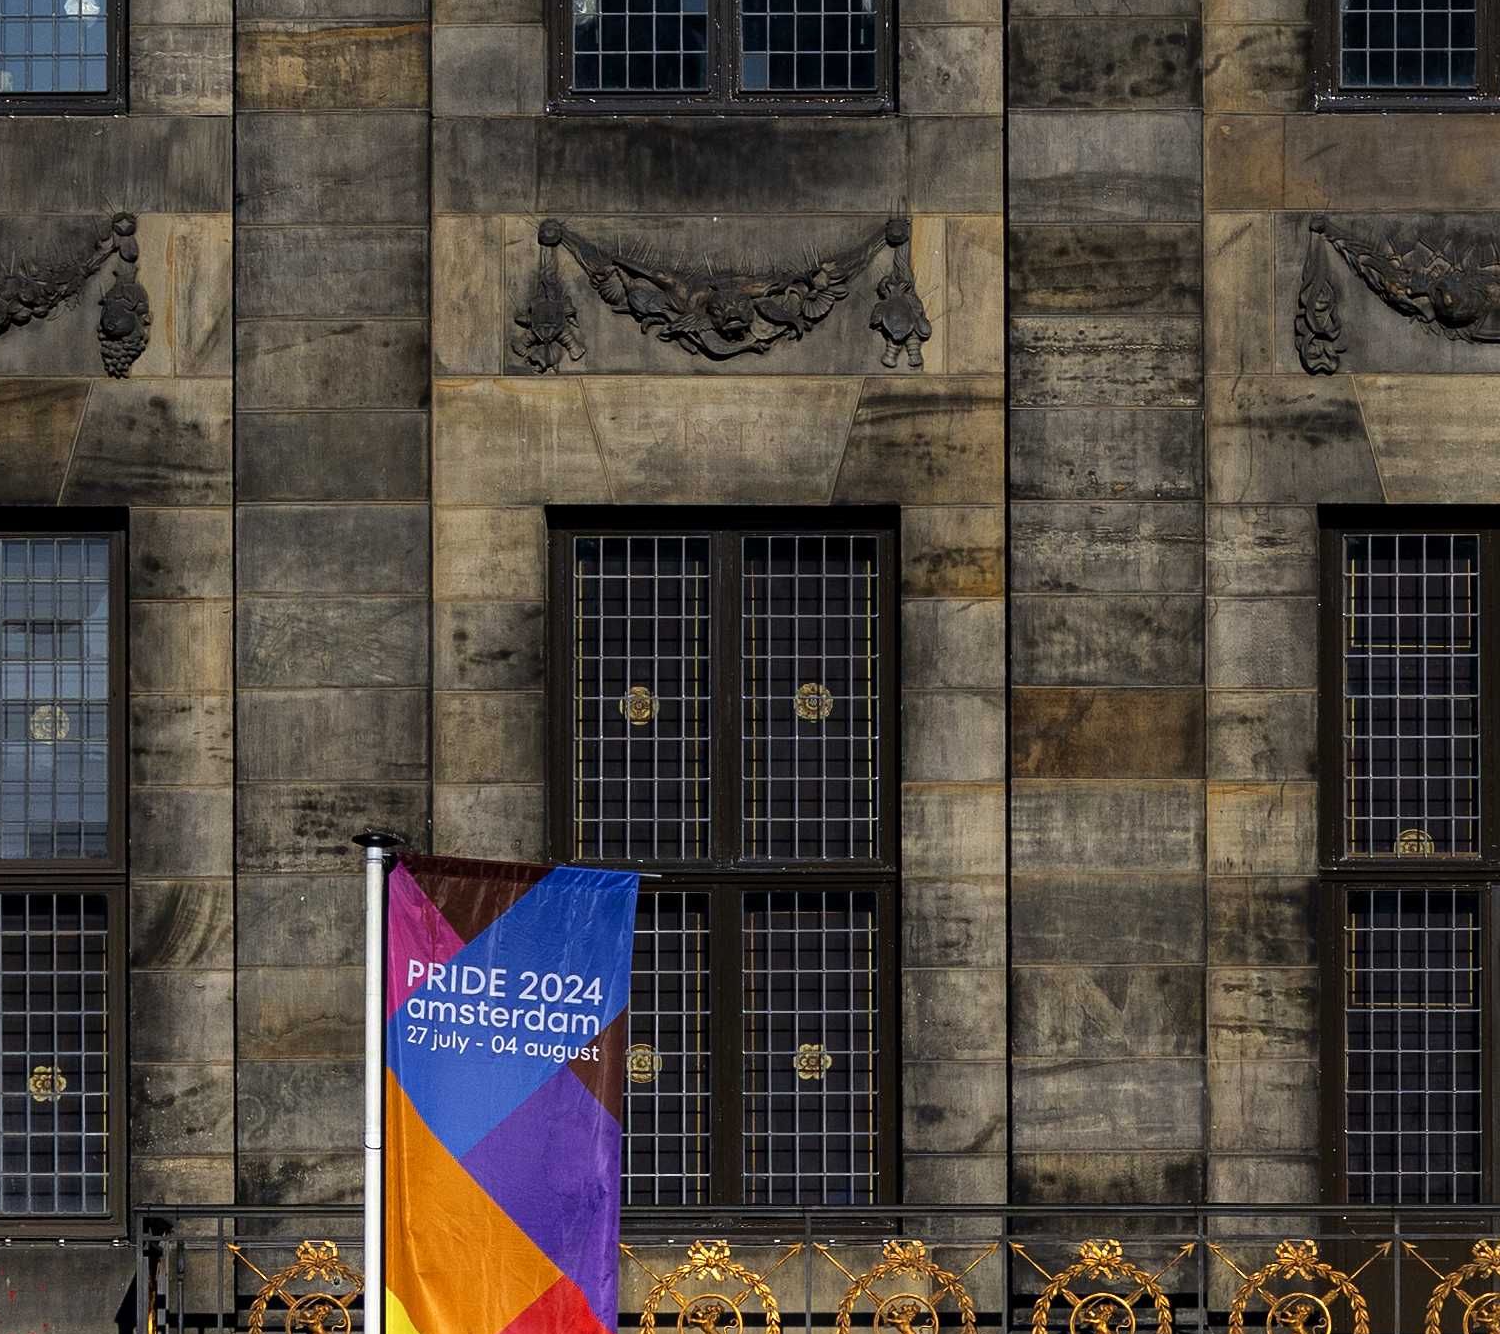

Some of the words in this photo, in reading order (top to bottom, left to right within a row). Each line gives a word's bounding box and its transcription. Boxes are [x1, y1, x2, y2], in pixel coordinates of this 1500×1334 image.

[407, 959, 507, 997] PRIDE
[518, 971, 603, 1006] 2024
[407, 997, 600, 1035] amsterdam
[407, 1025, 428, 1045] 27
[431, 1029, 469, 1054] july
[492, 1035, 518, 1055] 04
[524, 1042, 600, 1063] august
